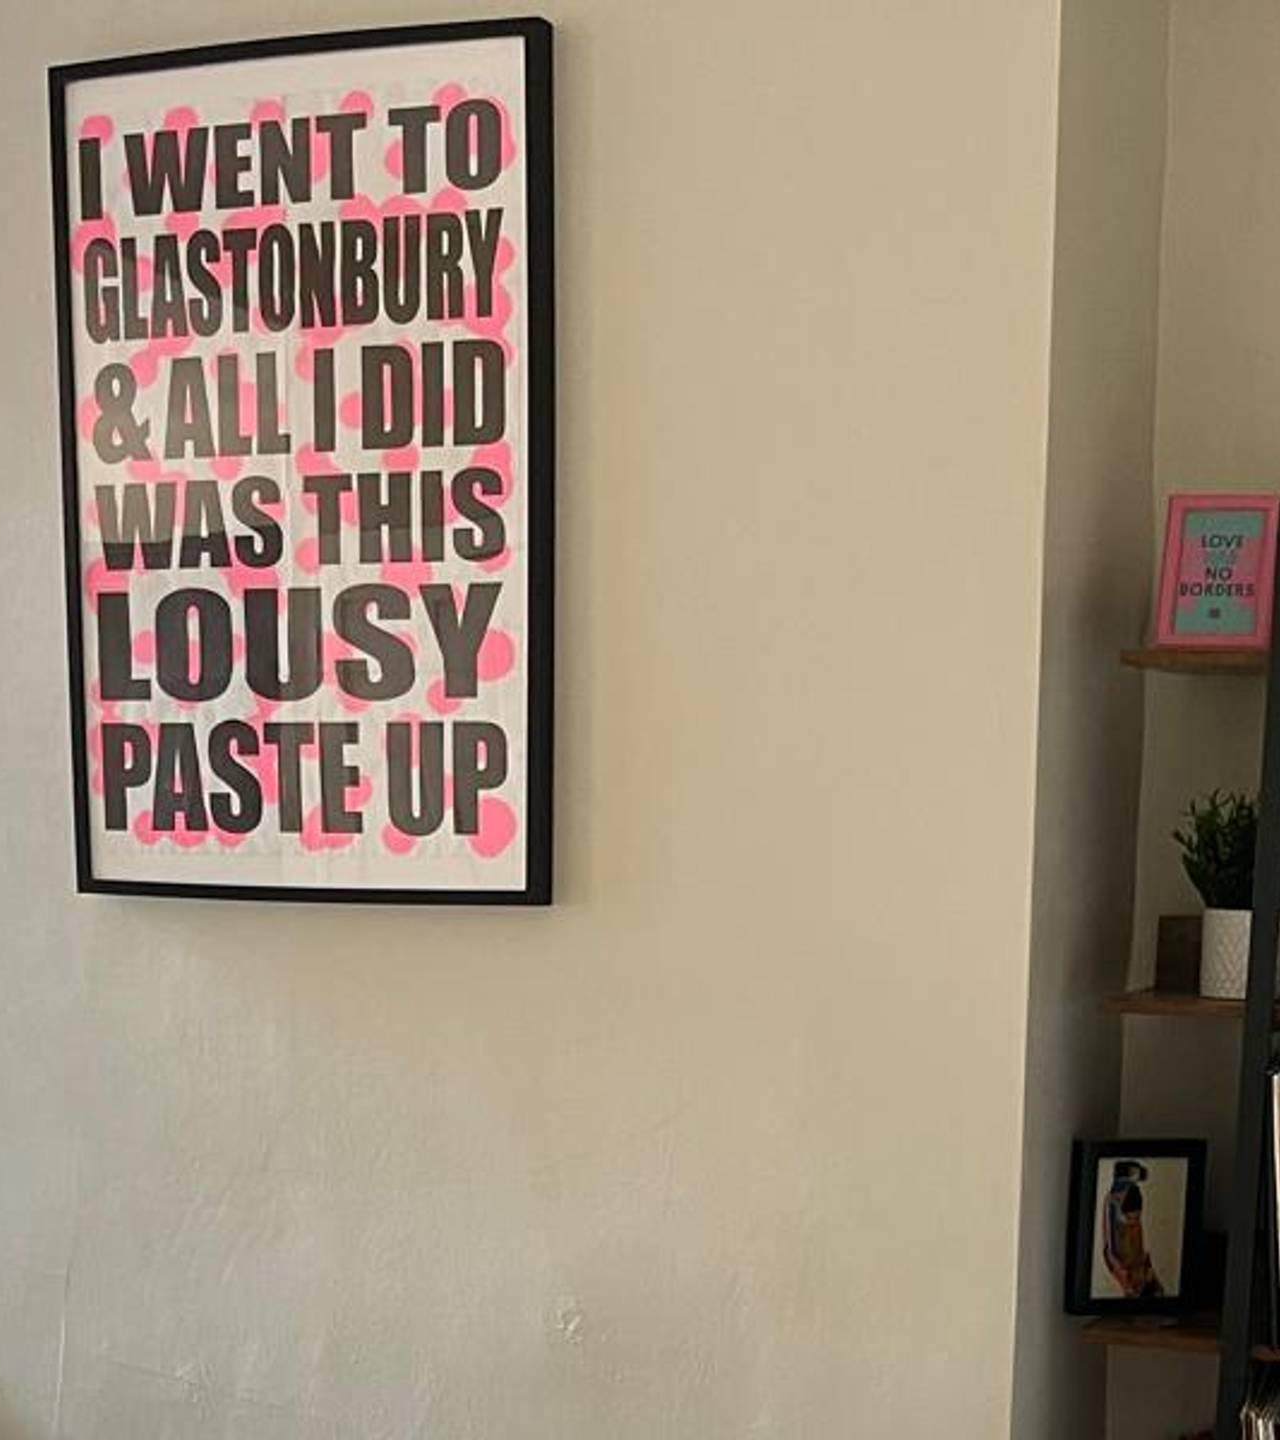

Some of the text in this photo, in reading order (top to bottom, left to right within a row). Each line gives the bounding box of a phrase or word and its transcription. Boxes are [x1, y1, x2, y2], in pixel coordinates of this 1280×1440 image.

[78, 98, 503, 221] I WENT TO
[82, 207, 504, 345] GLASTONBURY
[93, 340, 505, 465] & ALL I DID
[95, 467, 506, 571] WAS THIS
[1201, 534, 1244, 549] LOVE
[1205, 567, 1232, 581] NO
[95, 582, 503, 702] LOUSY
[1179, 582, 1256, 597] BORDERS
[101, 720, 509, 836] PASTE UP
